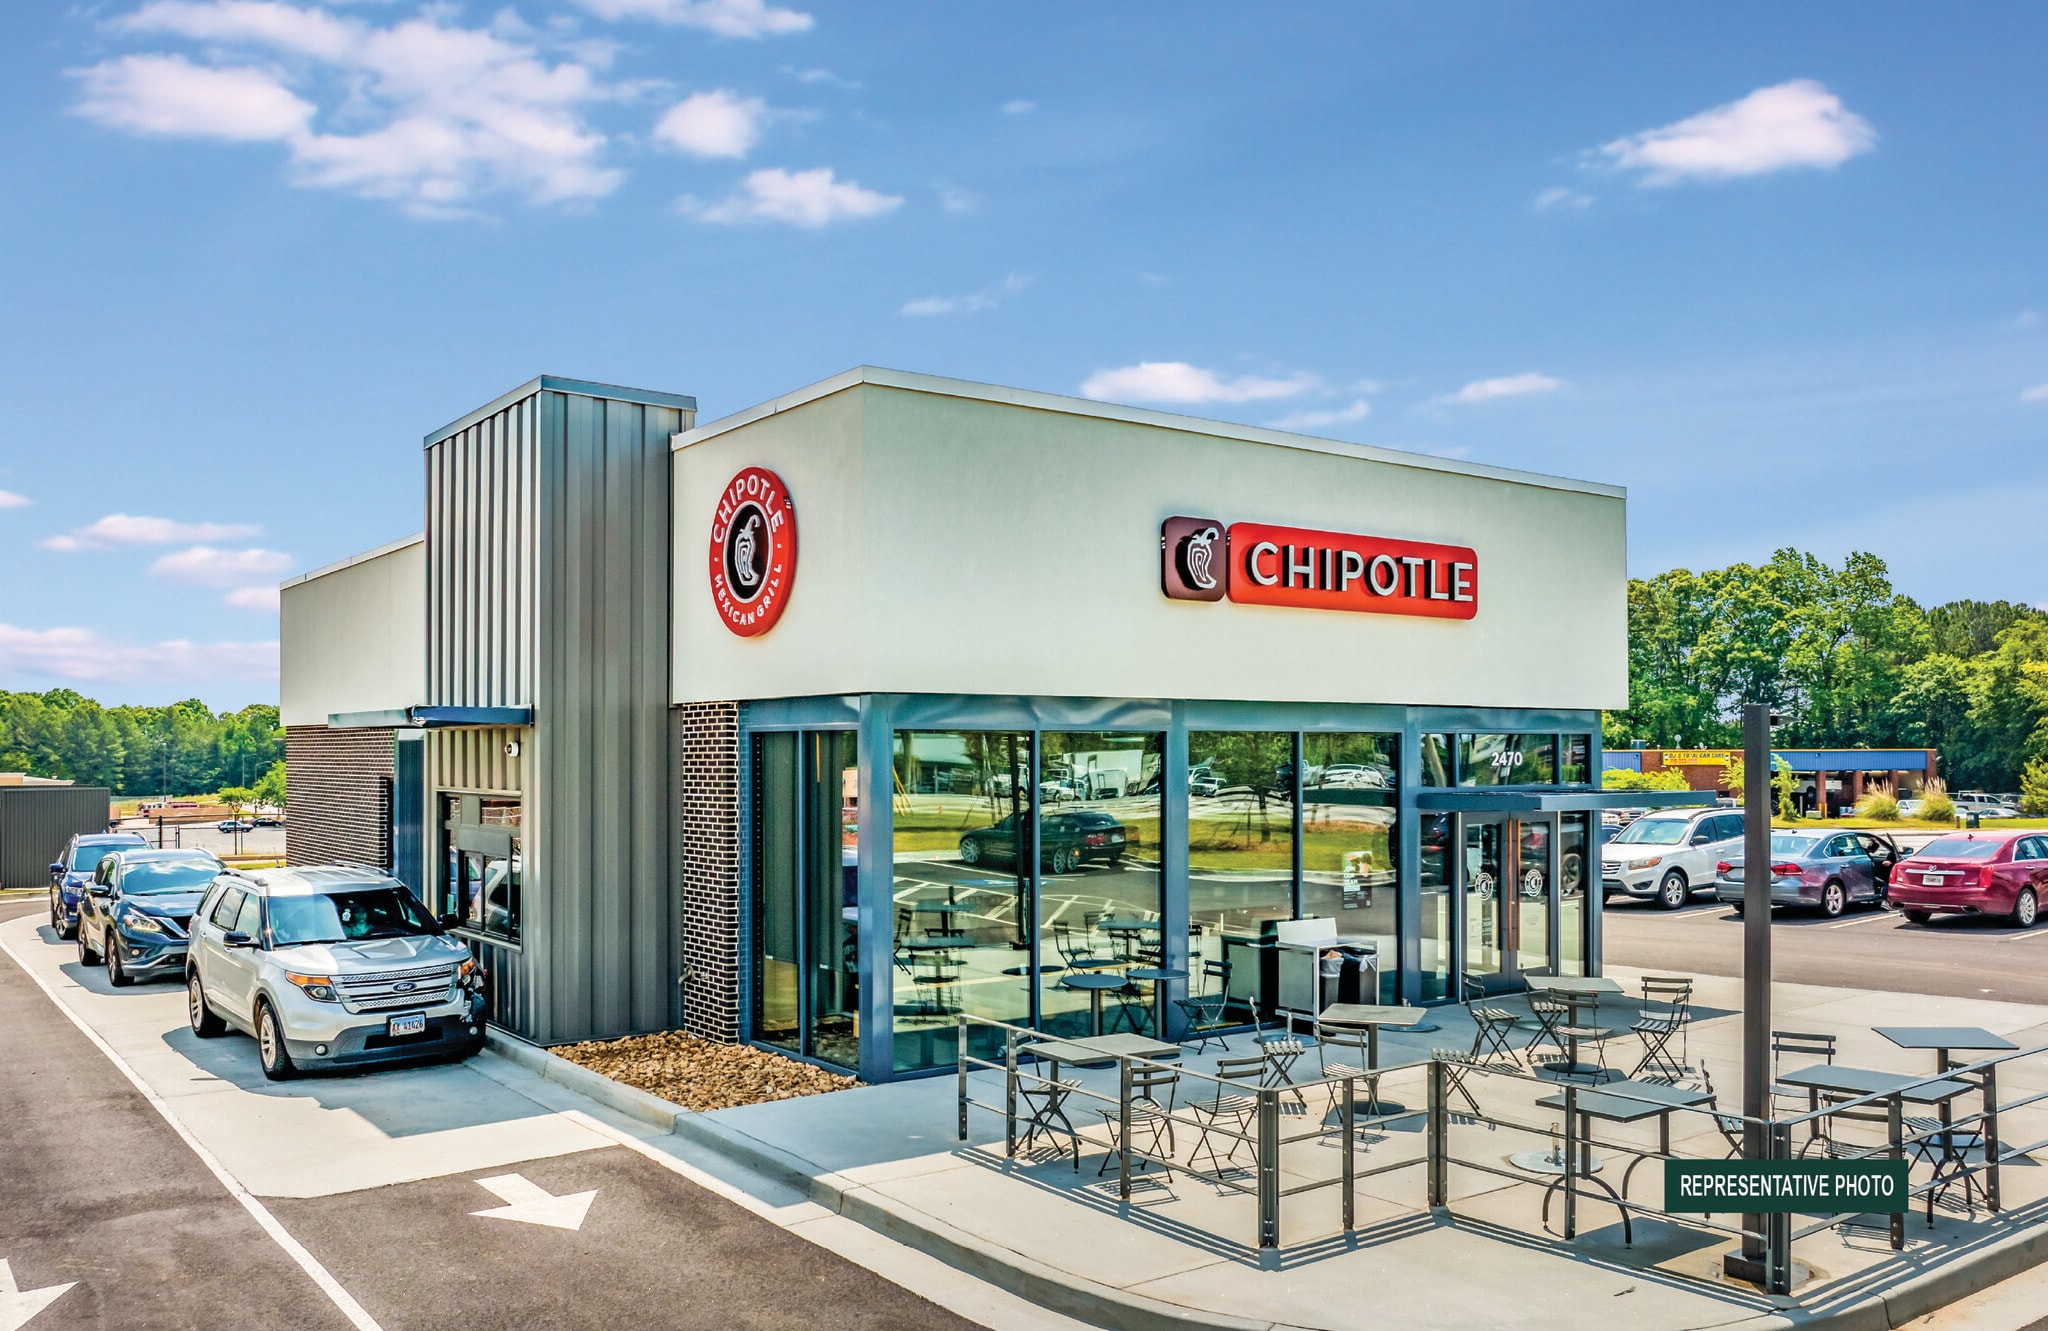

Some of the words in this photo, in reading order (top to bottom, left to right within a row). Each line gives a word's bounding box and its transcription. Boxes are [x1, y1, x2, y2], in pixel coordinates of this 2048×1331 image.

[713, 474, 784, 543] CHIPOTLE
[714, 574, 755, 625] MEXICAN
[756, 564, 782, 617] GRILL
[1251, 541, 1474, 602] CHIPOTLE
[1491, 751, 1523, 767] 2470
